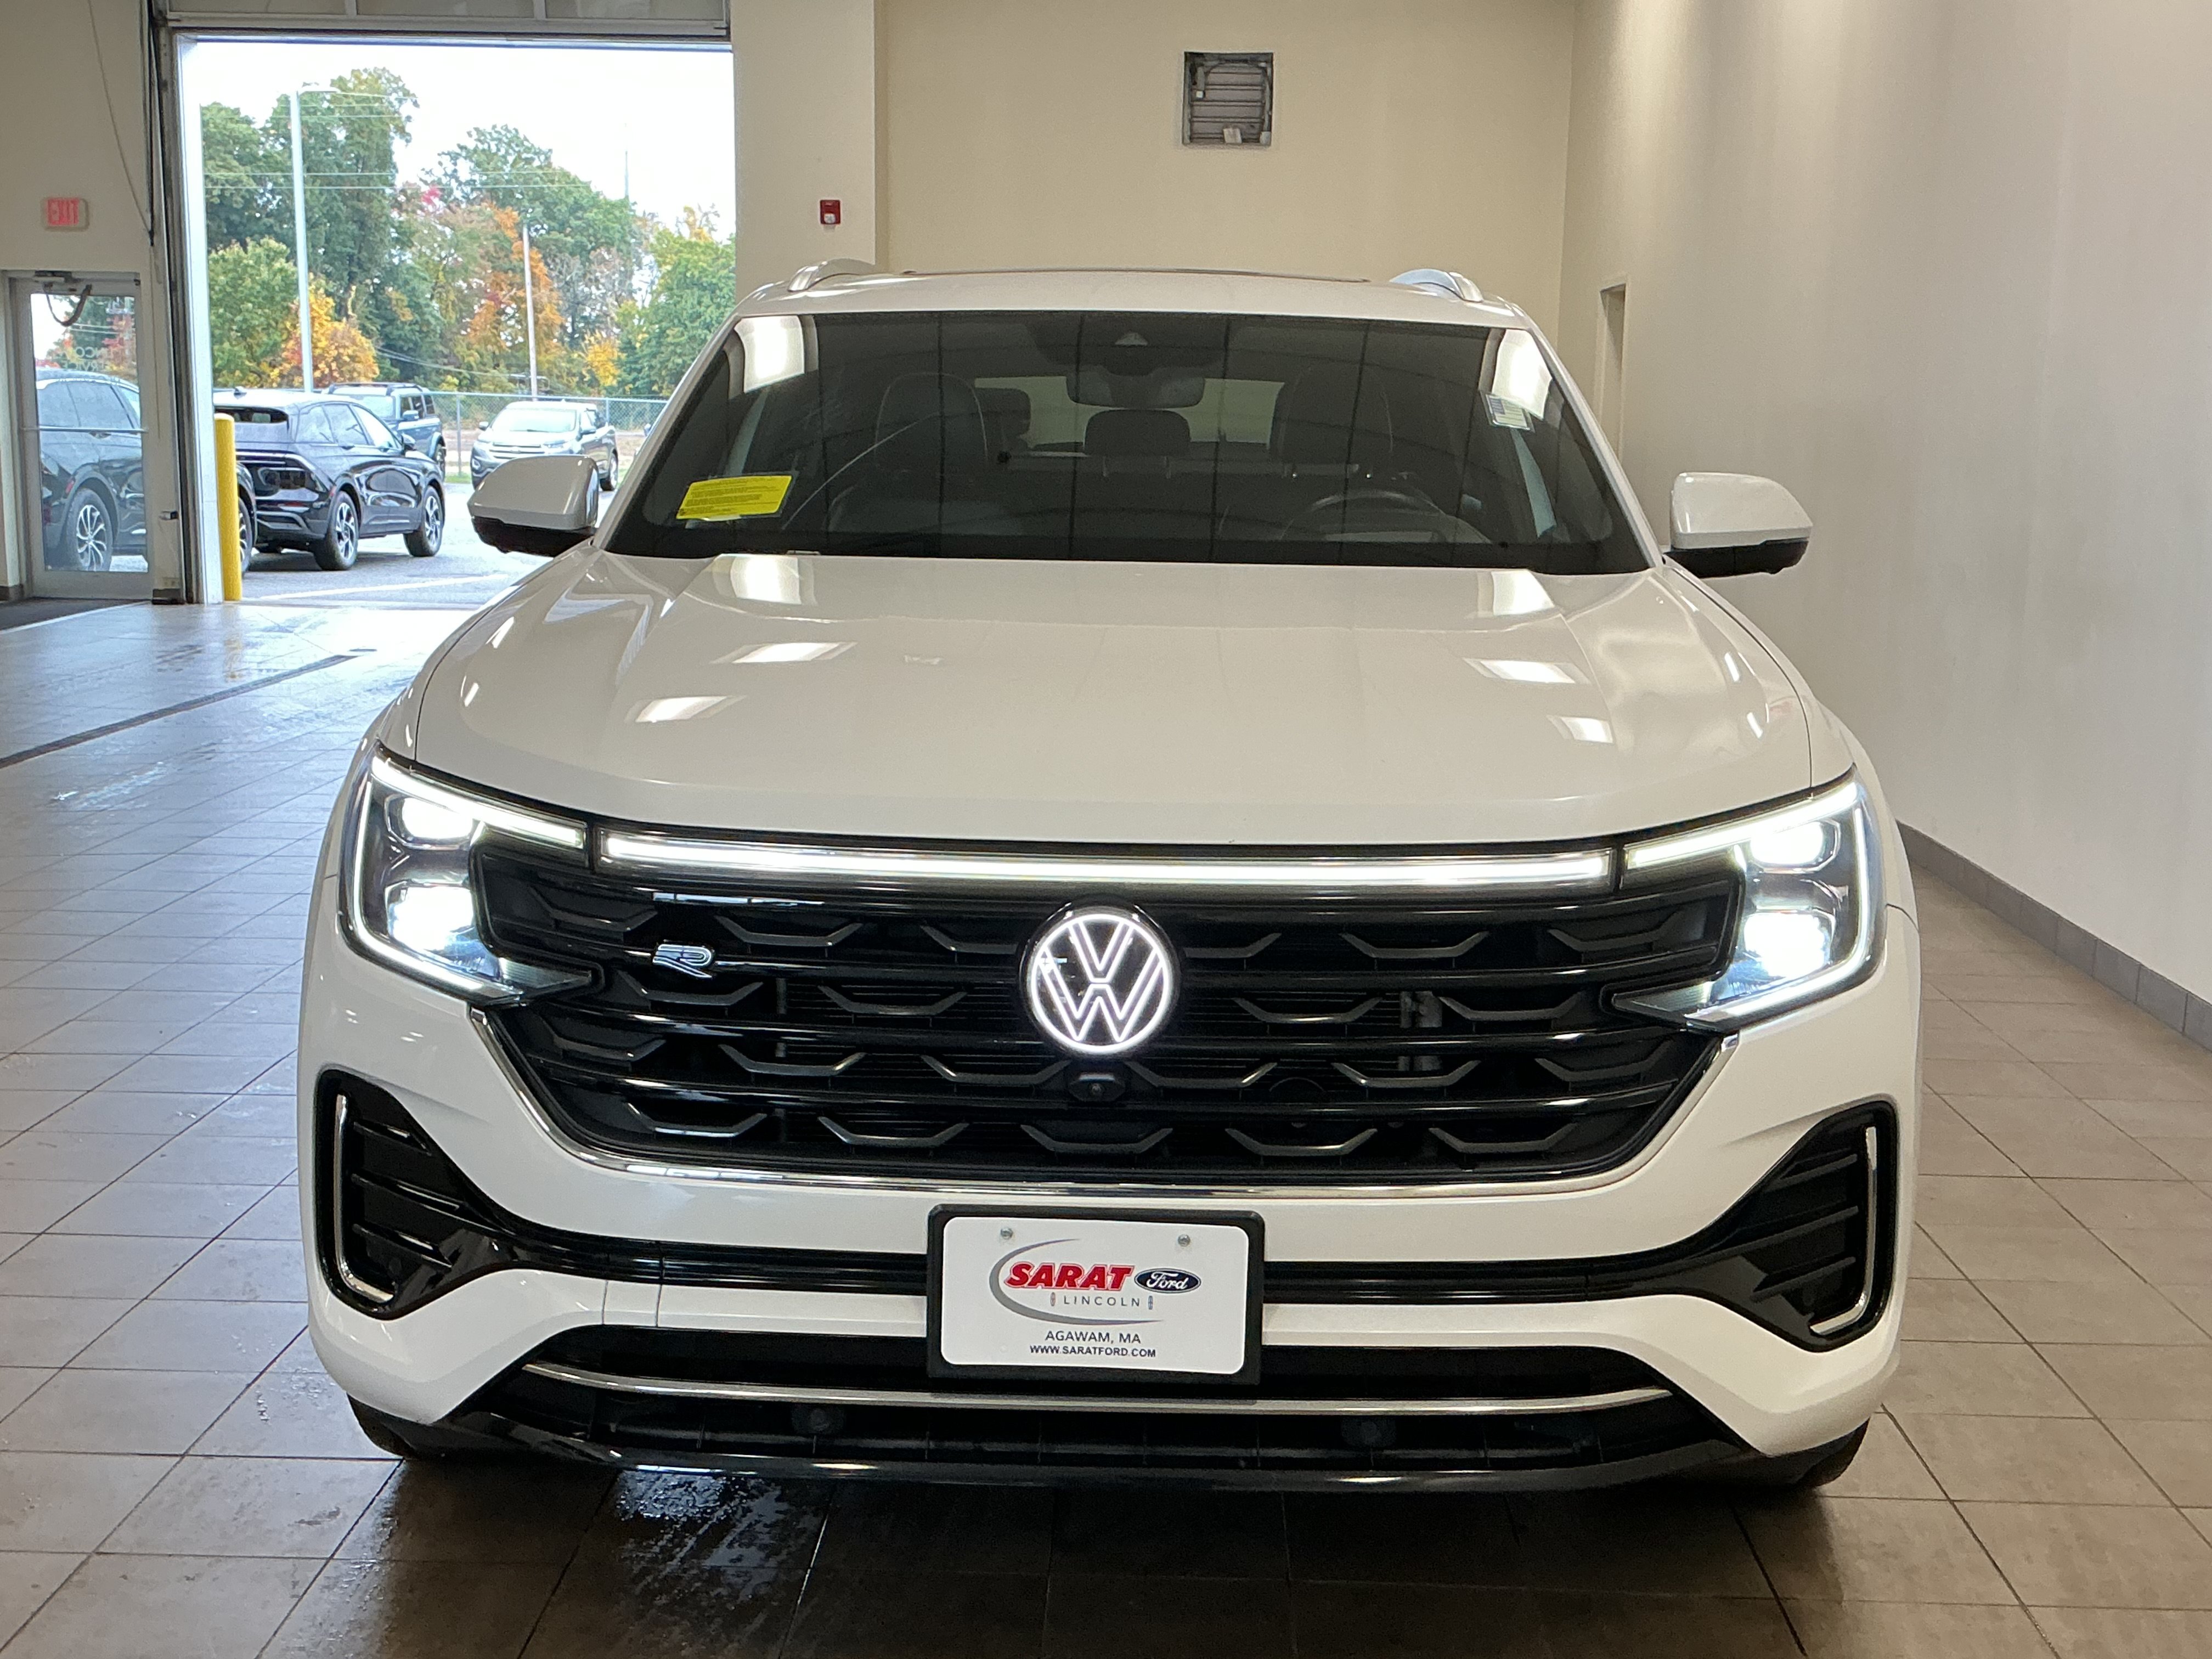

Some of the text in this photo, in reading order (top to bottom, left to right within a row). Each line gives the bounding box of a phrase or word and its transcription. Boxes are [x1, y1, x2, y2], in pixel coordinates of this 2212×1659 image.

[1004, 1262, 1189, 1291] SARAT Ford
[1064, 1295, 1140, 1307] LINCOLN
[1045, 1330, 1142, 1344] AGAWAM, MA
[1030, 1345, 1156, 1357] WWW.SARATFORD.COM
